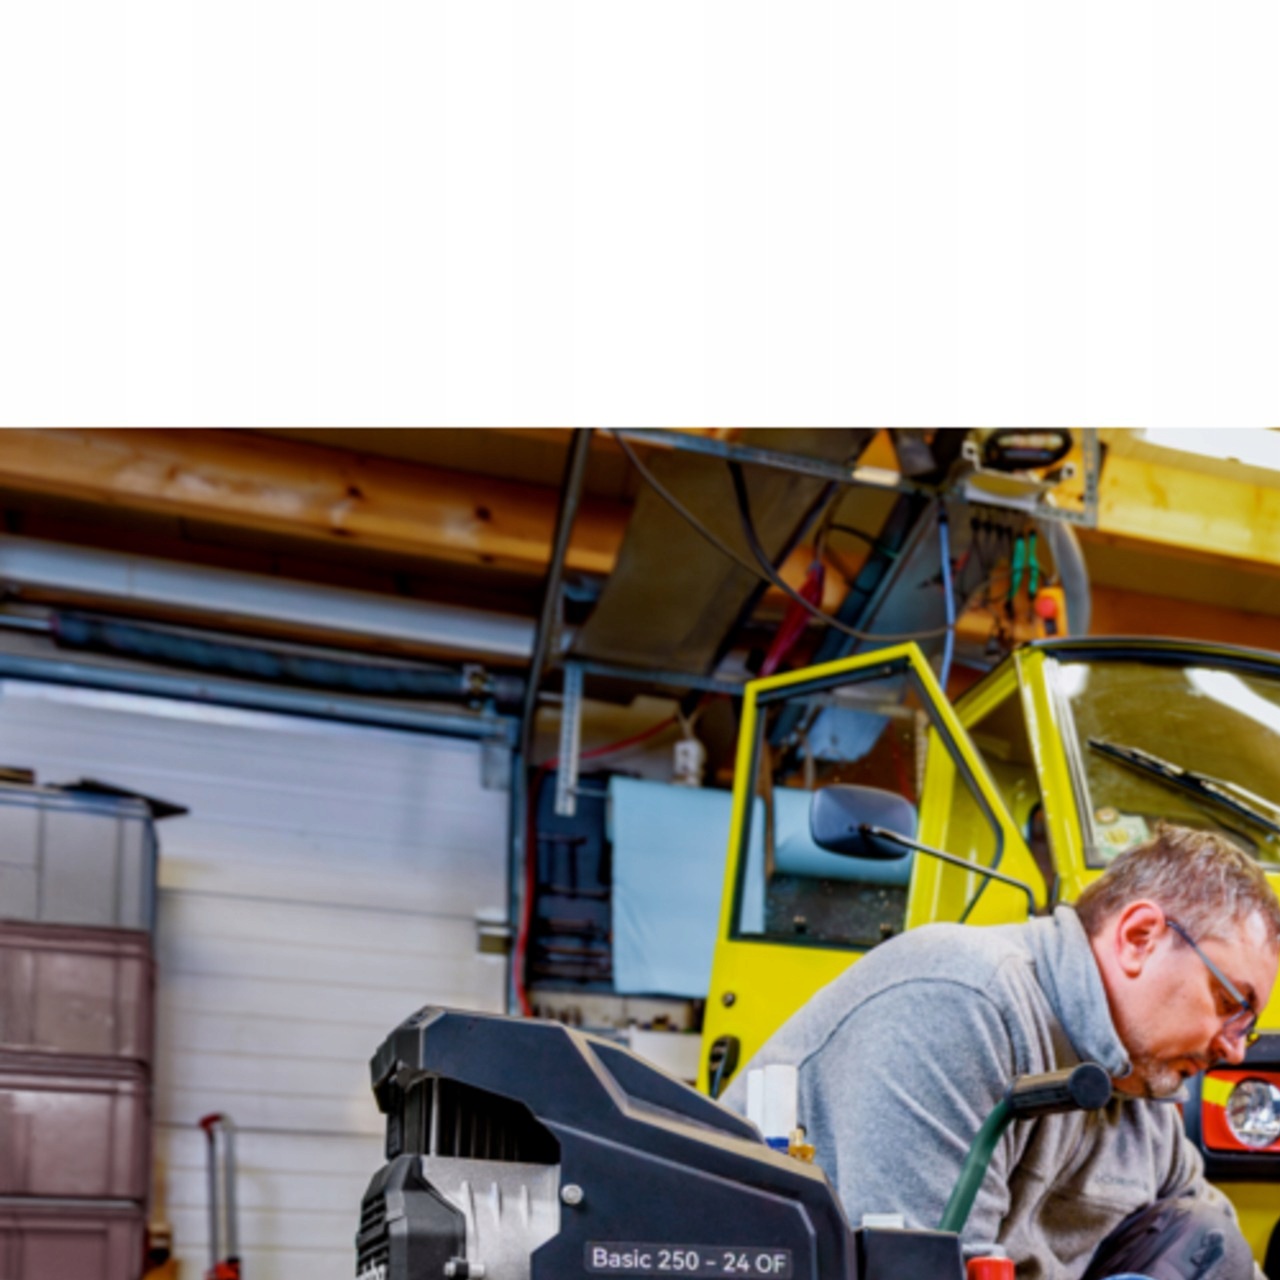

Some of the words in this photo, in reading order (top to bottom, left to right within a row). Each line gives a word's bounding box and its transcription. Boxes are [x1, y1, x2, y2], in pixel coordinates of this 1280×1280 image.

[592, 1247, 652, 1269] Basic
[657, 1250, 700, 1272] 250
[723, 1252, 750, 1273] 24
[755, 1253, 787, 1274] OF
